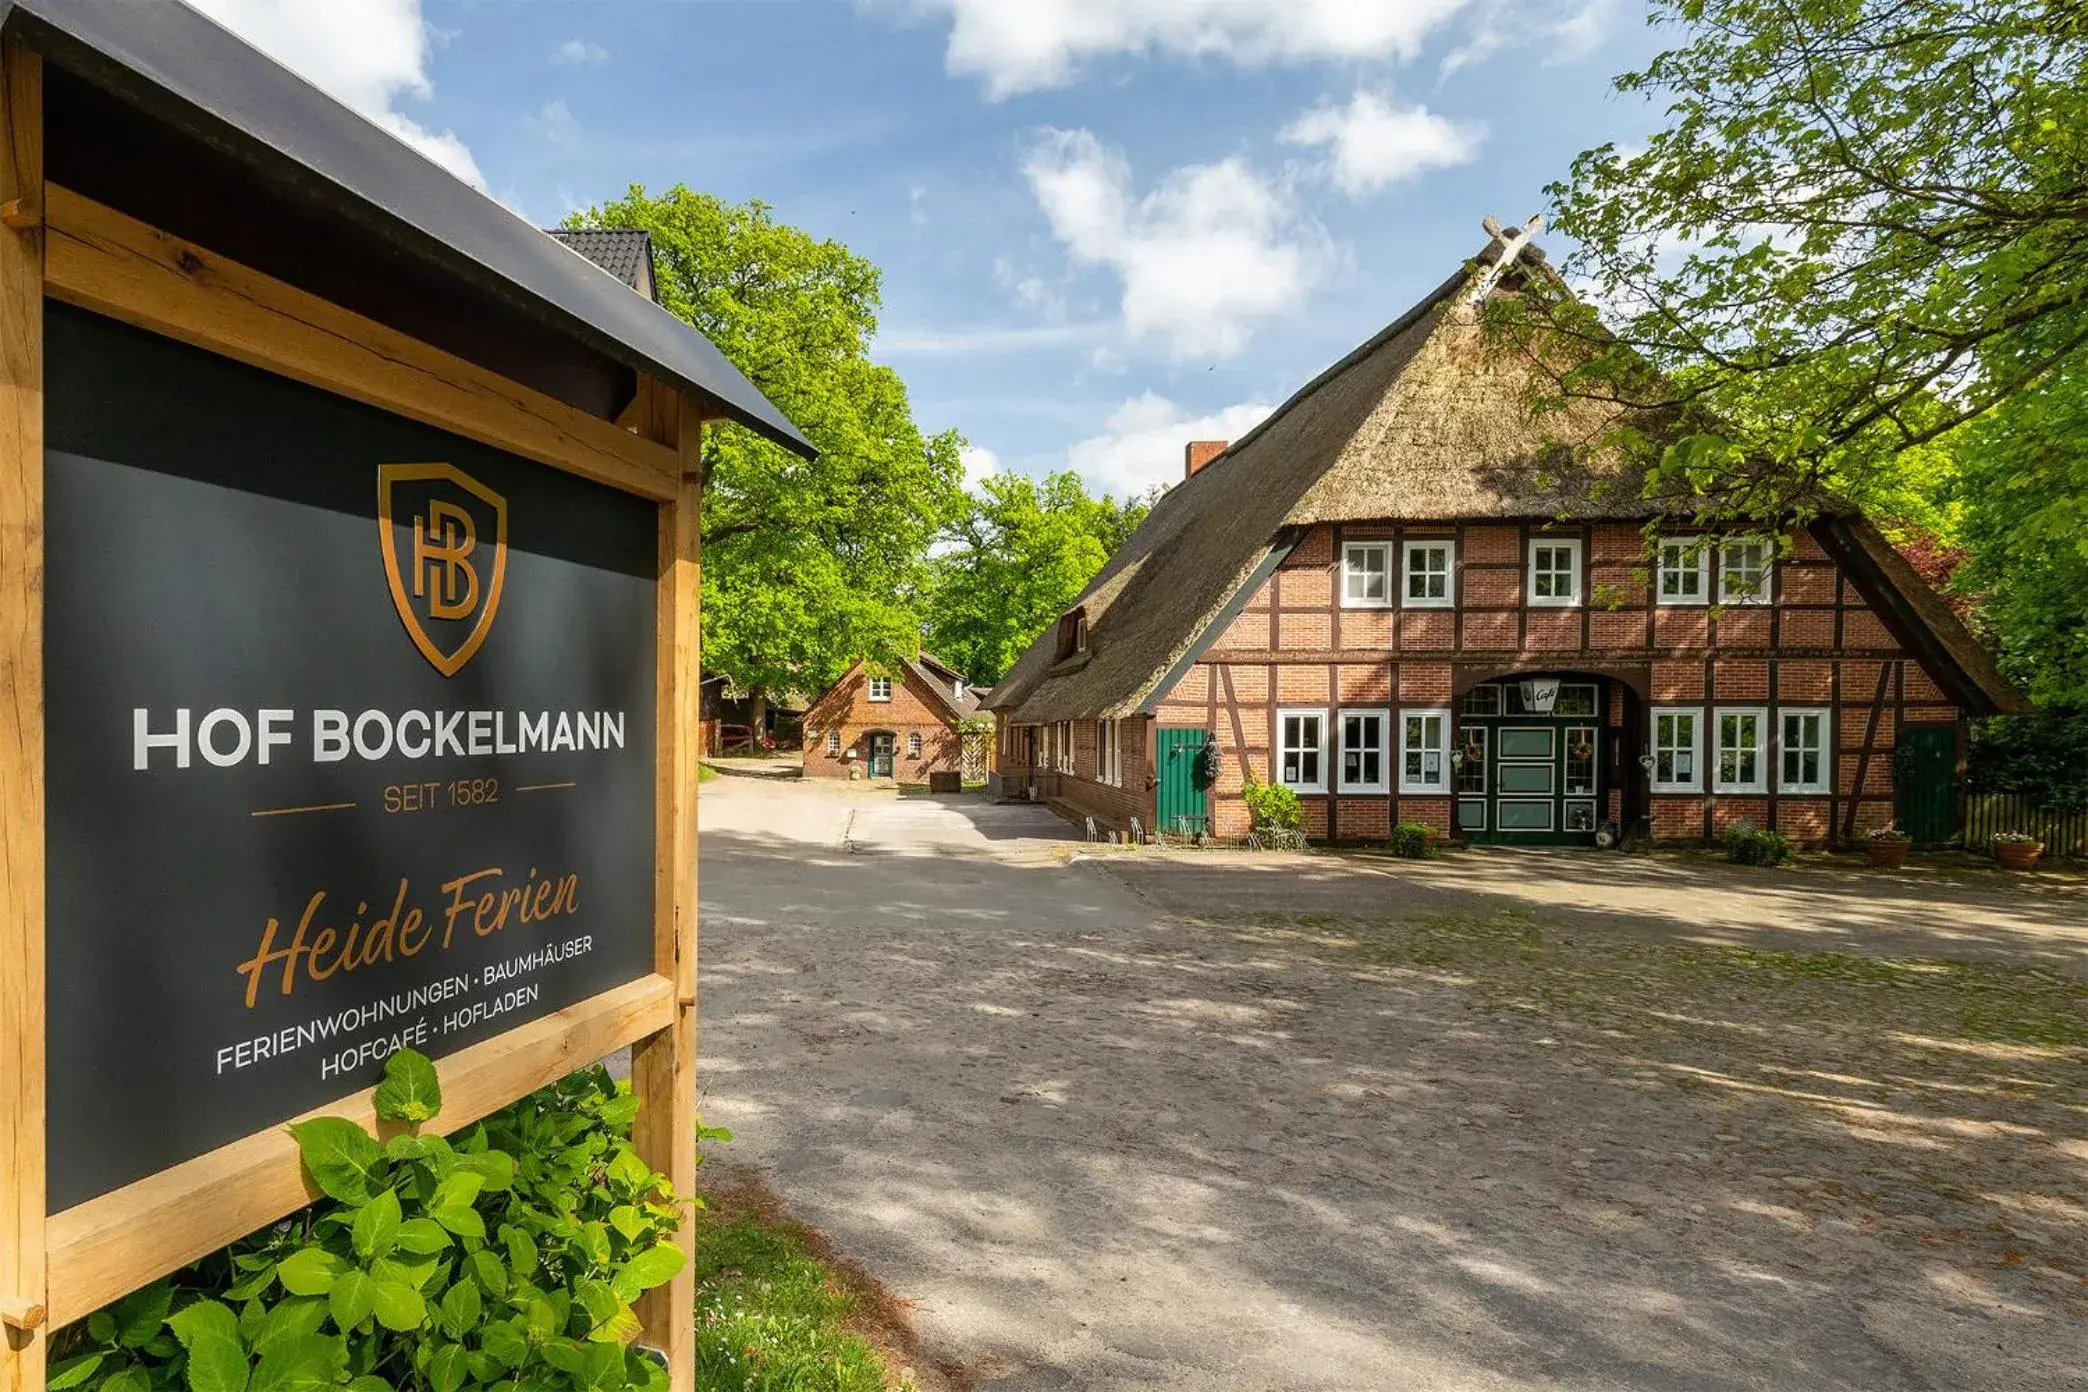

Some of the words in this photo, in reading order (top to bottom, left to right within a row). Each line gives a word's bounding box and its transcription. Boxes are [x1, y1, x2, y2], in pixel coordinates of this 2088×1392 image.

[1536, 687, 1557, 702] Café
[133, 708, 294, 770] HOF
[313, 709, 625, 763] BOCKELMANN
[384, 781, 441, 813] SEIT
[448, 778, 499, 807] 1582
[236, 878, 432, 1008] Heide
[441, 868, 580, 950] Ferien
[216, 974, 469, 1074] FERIENWOHNUNGEN
[483, 935, 593, 986] BAUMHÄUSER
[322, 1020, 428, 1081] HOFCAFÉ
[443, 983, 539, 1036] HOFLADEN
